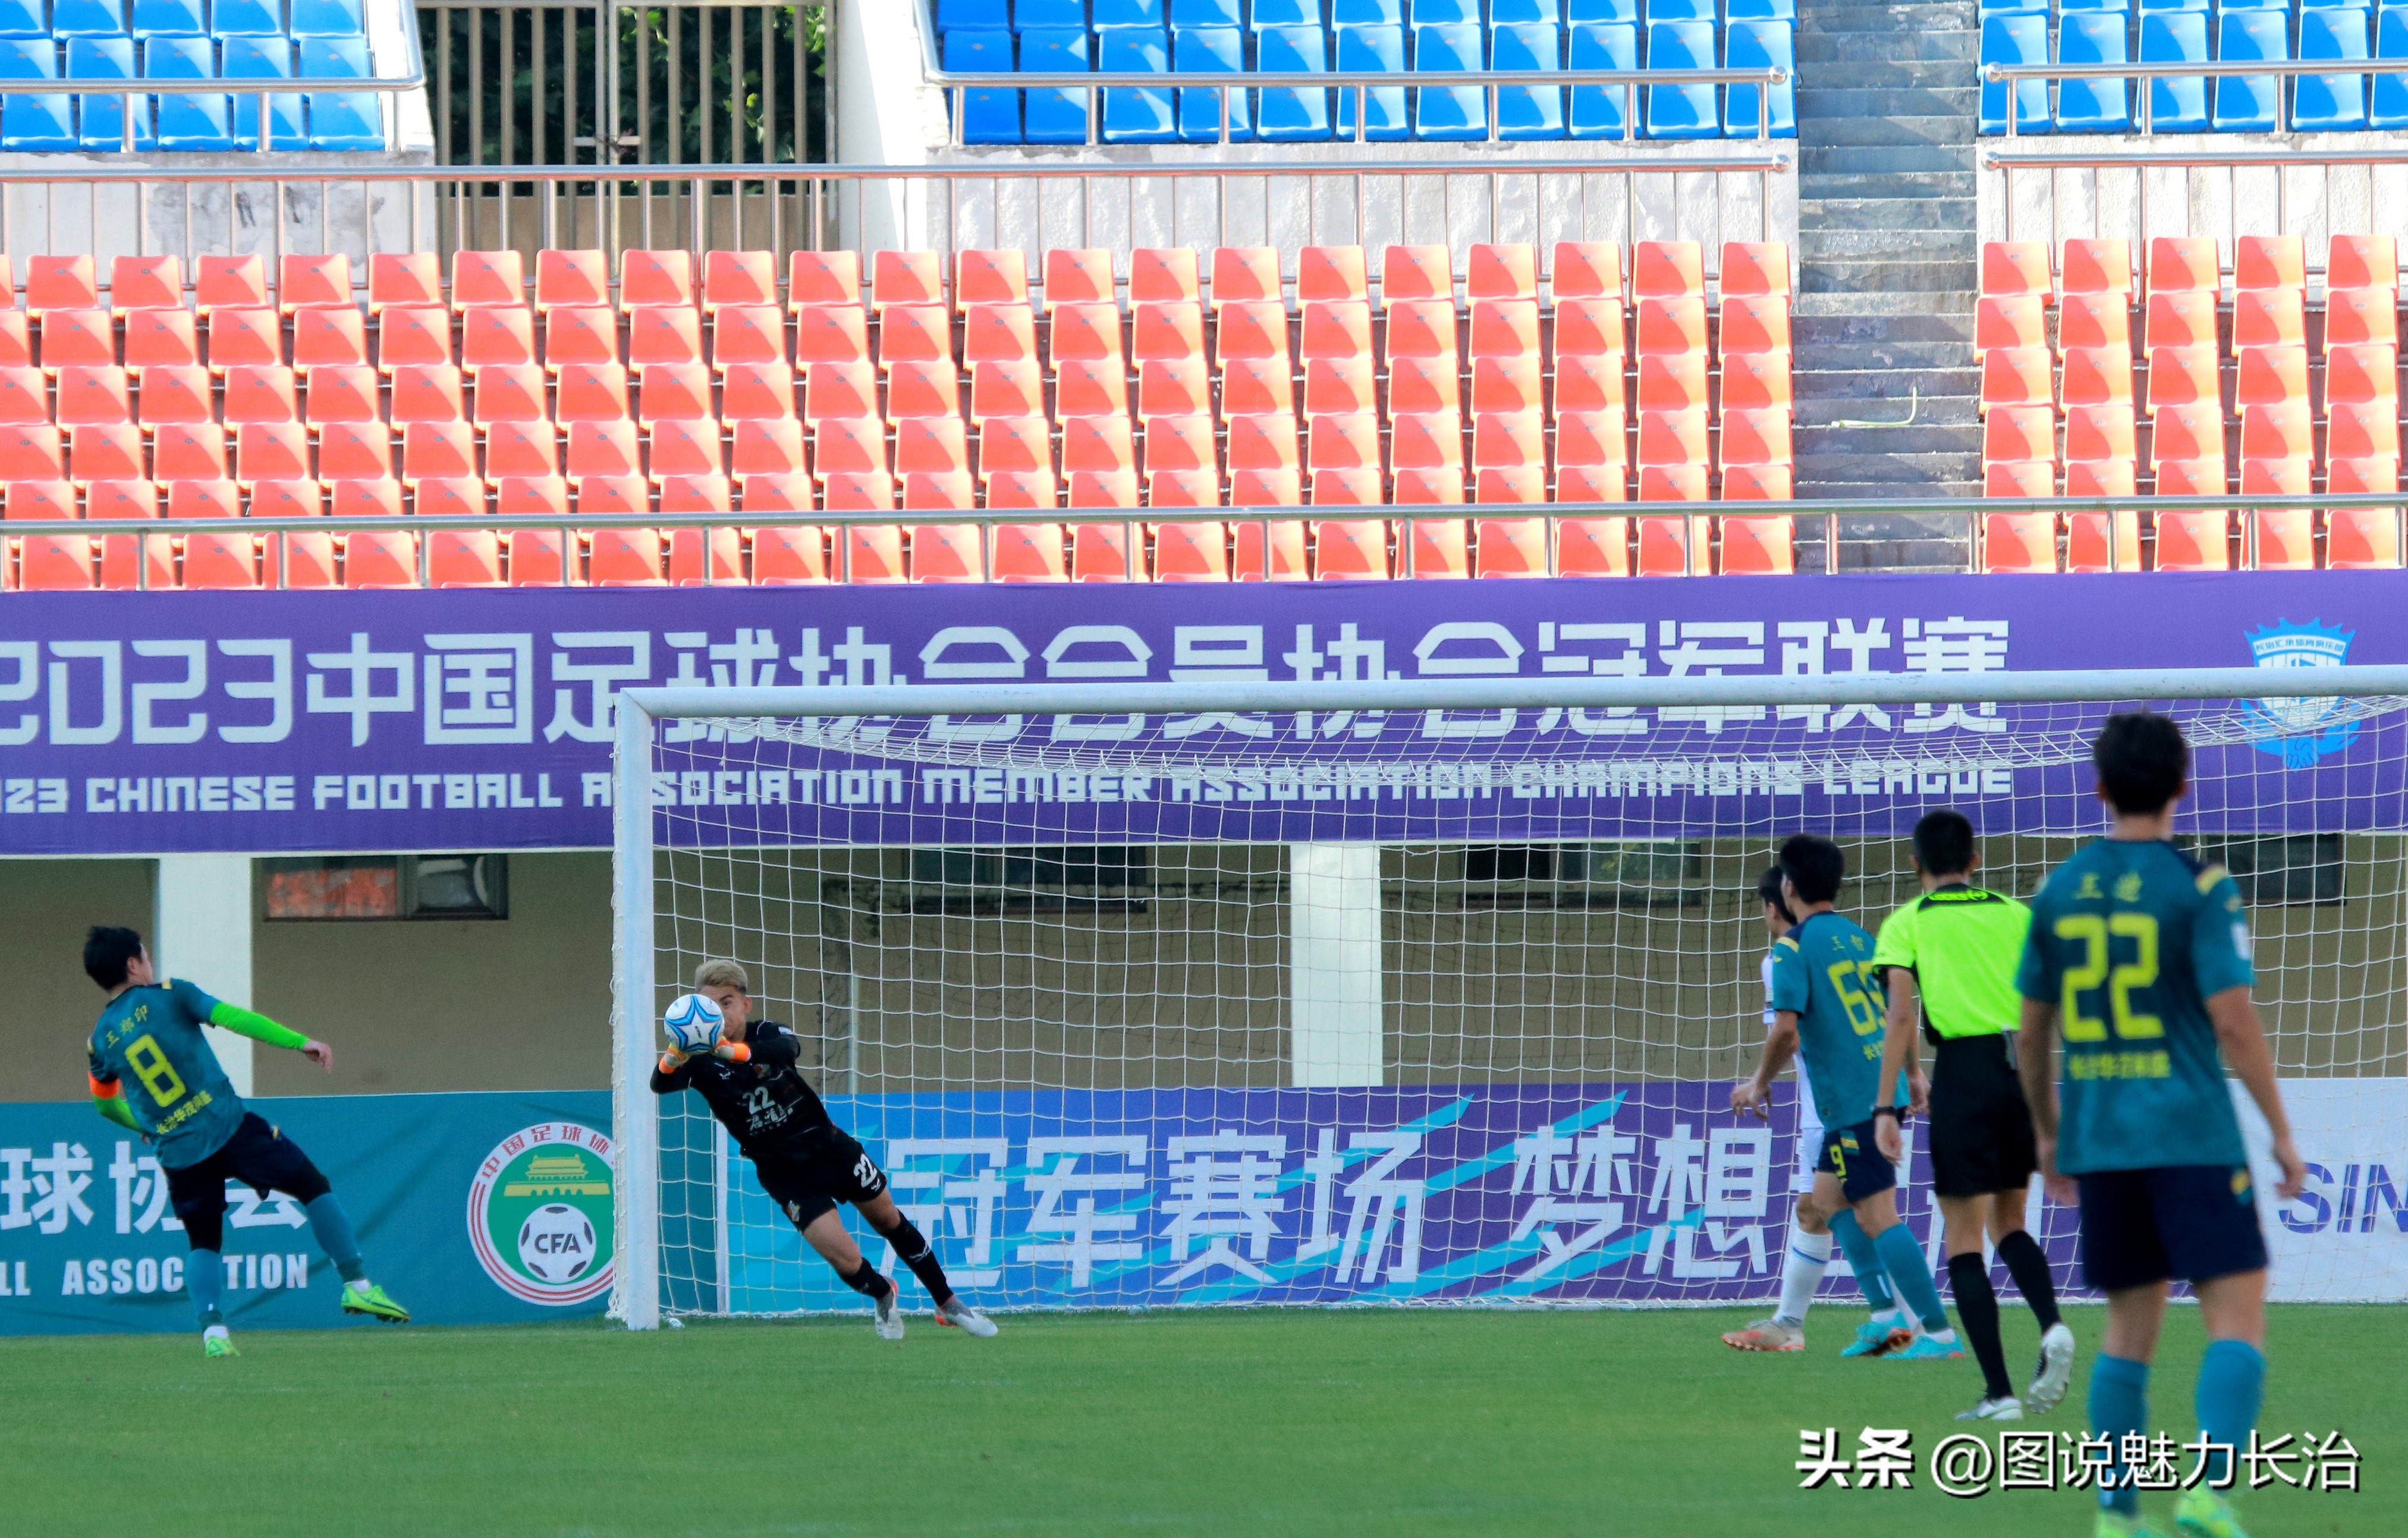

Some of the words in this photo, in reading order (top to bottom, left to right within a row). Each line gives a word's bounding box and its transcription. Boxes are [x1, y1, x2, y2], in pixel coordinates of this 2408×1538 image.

[0, 777, 67, 813] 23
[86, 776, 295, 813] CHINESE
[313, 772, 563, 810] FOOTBALL
[581, 769, 903, 807] ASOCIATION
[923, 767, 1152, 804] MEMBER
[1171, 763, 1492, 801] ASSOCIATION
[1512, 761, 1804, 798] CHAMPIONS
[1824, 758, 2011, 795] LEAGUE
[2053, 913, 2166, 1042] 22
[124, 1033, 187, 1108] 8
[742, 1086, 776, 1115] 22
[482, 1124, 617, 1179] 中国足球协
[853, 1153, 878, 1188] 22
[881, 1128, 1425, 1287] 冠军赛场
[533, 1232, 581, 1254] CFA
[61, 1253, 309, 1295] ASSOCTION
